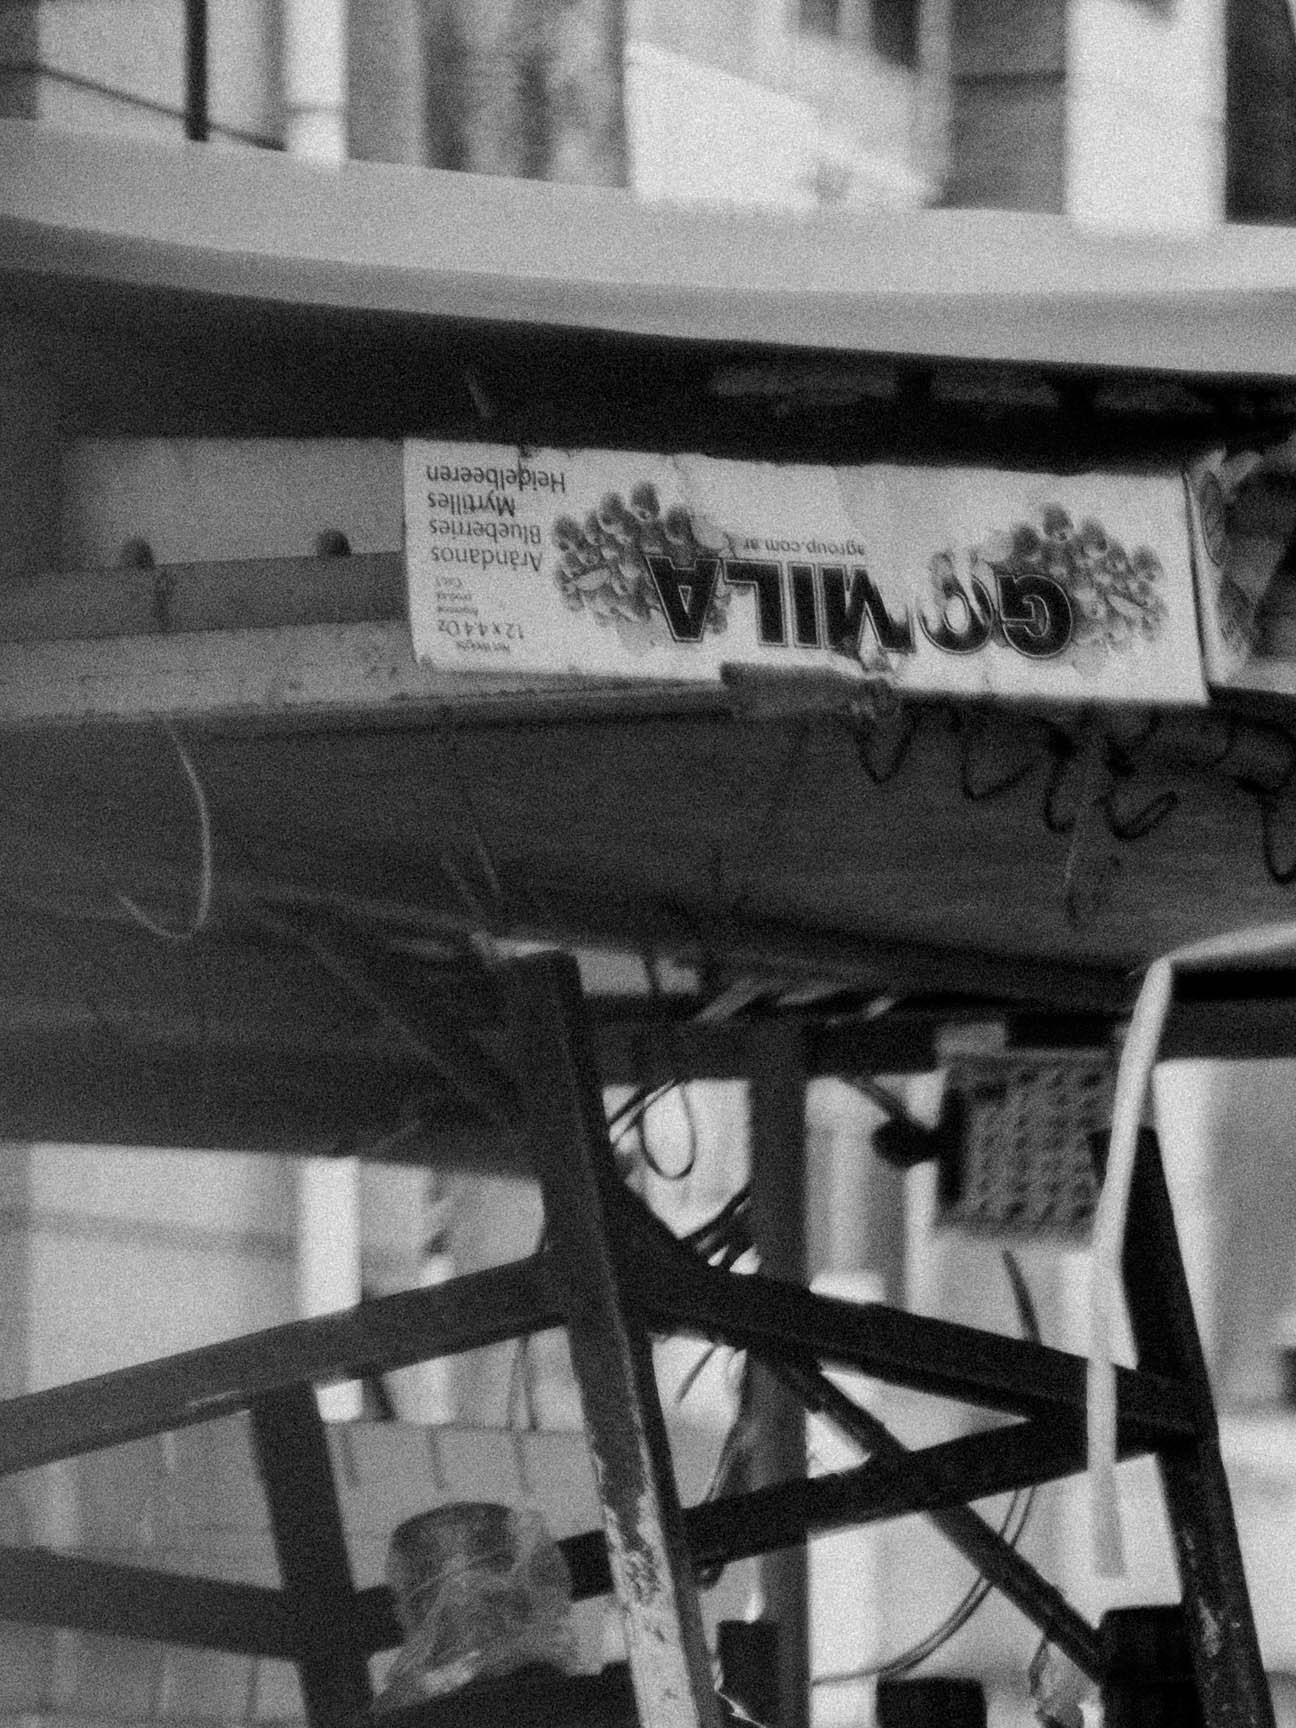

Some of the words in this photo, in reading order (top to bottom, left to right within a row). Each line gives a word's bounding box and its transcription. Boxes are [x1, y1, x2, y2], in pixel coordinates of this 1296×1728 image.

[426, 465, 566, 494] Heidelbeeren
[427, 489, 516, 518] Myrtilles
[429, 519, 541, 545] Blueberries
[645, 553, 1074, 660] GOMILA
[438, 619, 461, 637] Oz
[506, 624, 524, 639] 12
